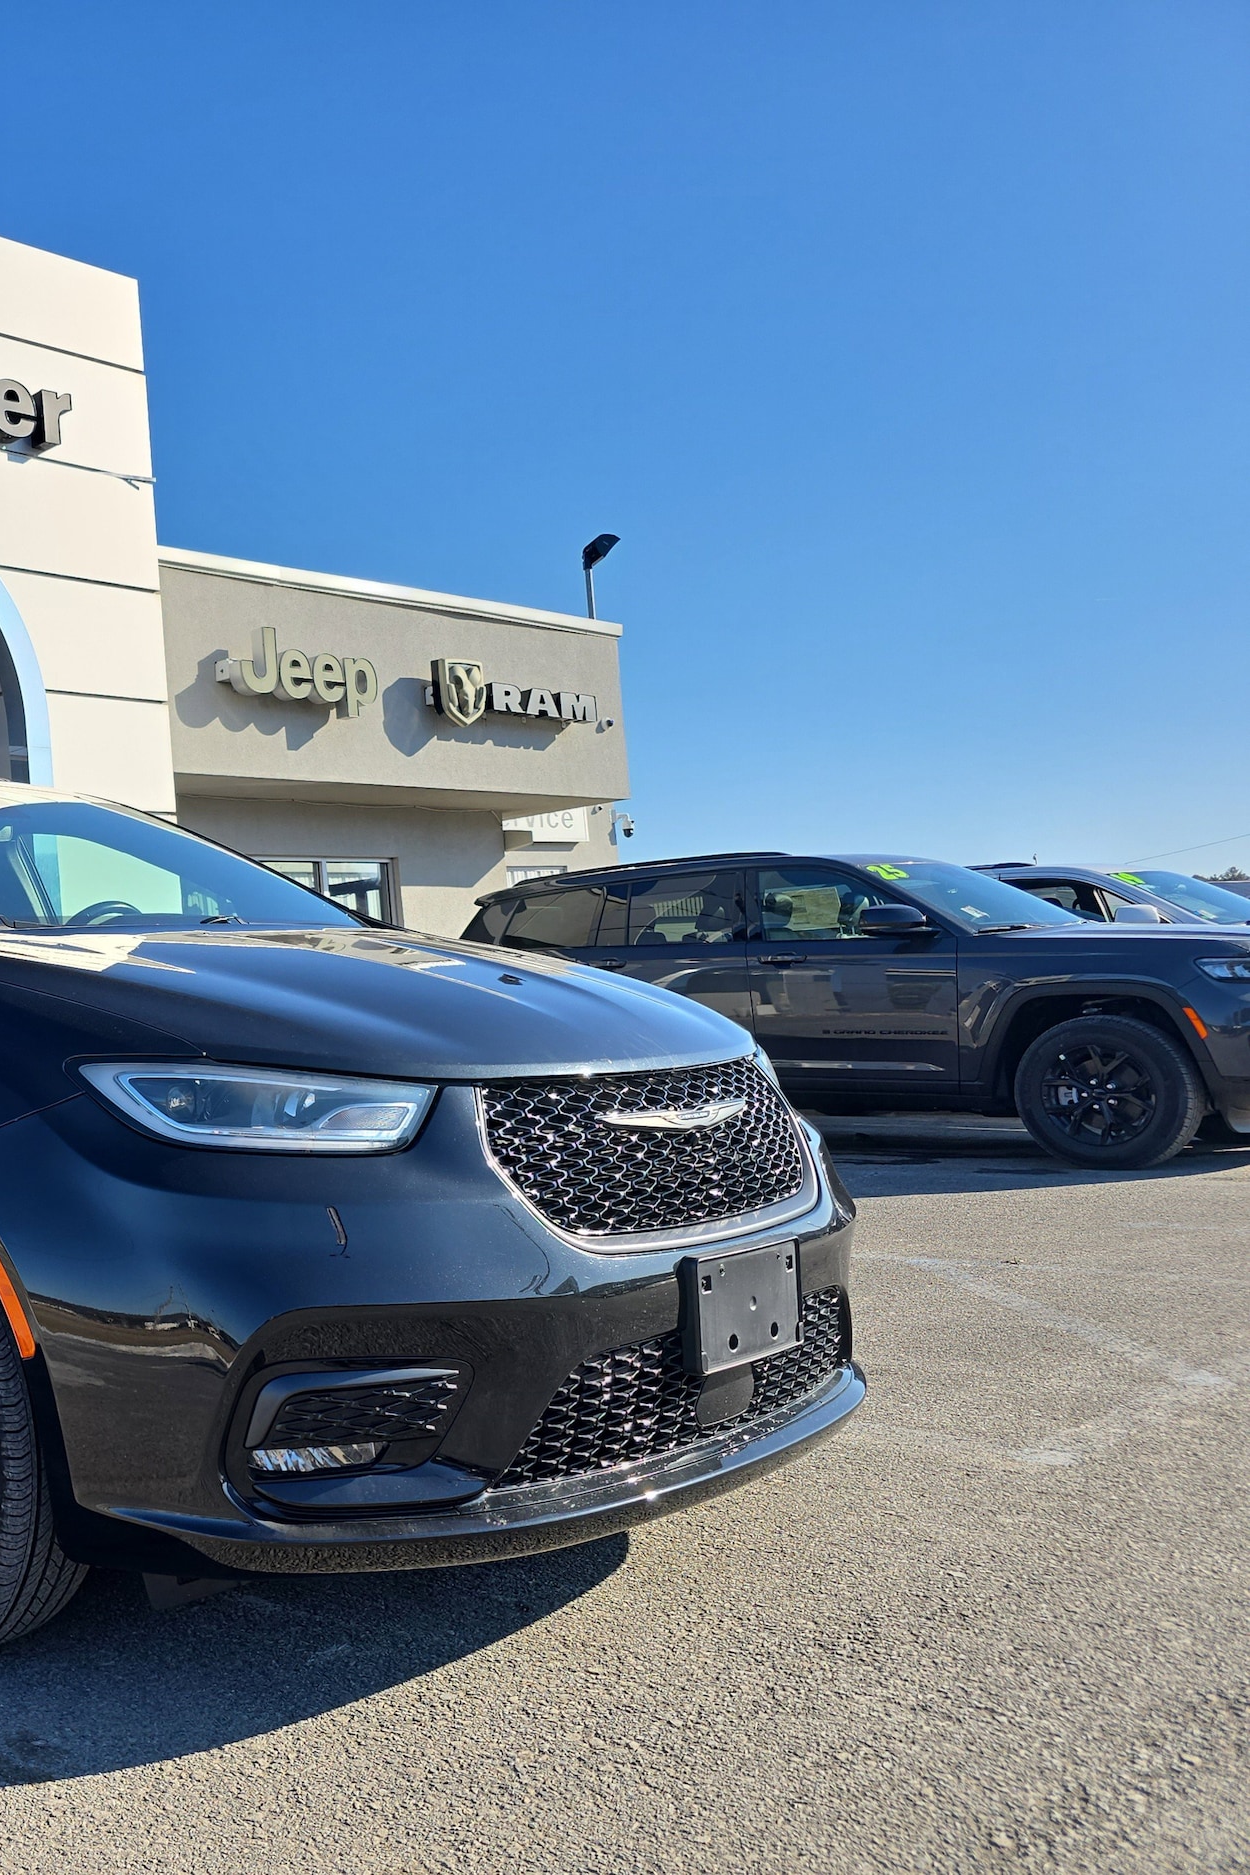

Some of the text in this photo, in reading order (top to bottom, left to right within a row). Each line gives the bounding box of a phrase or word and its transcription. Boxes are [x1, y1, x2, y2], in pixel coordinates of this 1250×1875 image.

[231, 626, 378, 719] Jeep
[487, 682, 598, 722] RAM
[865, 864, 910, 880] 25
